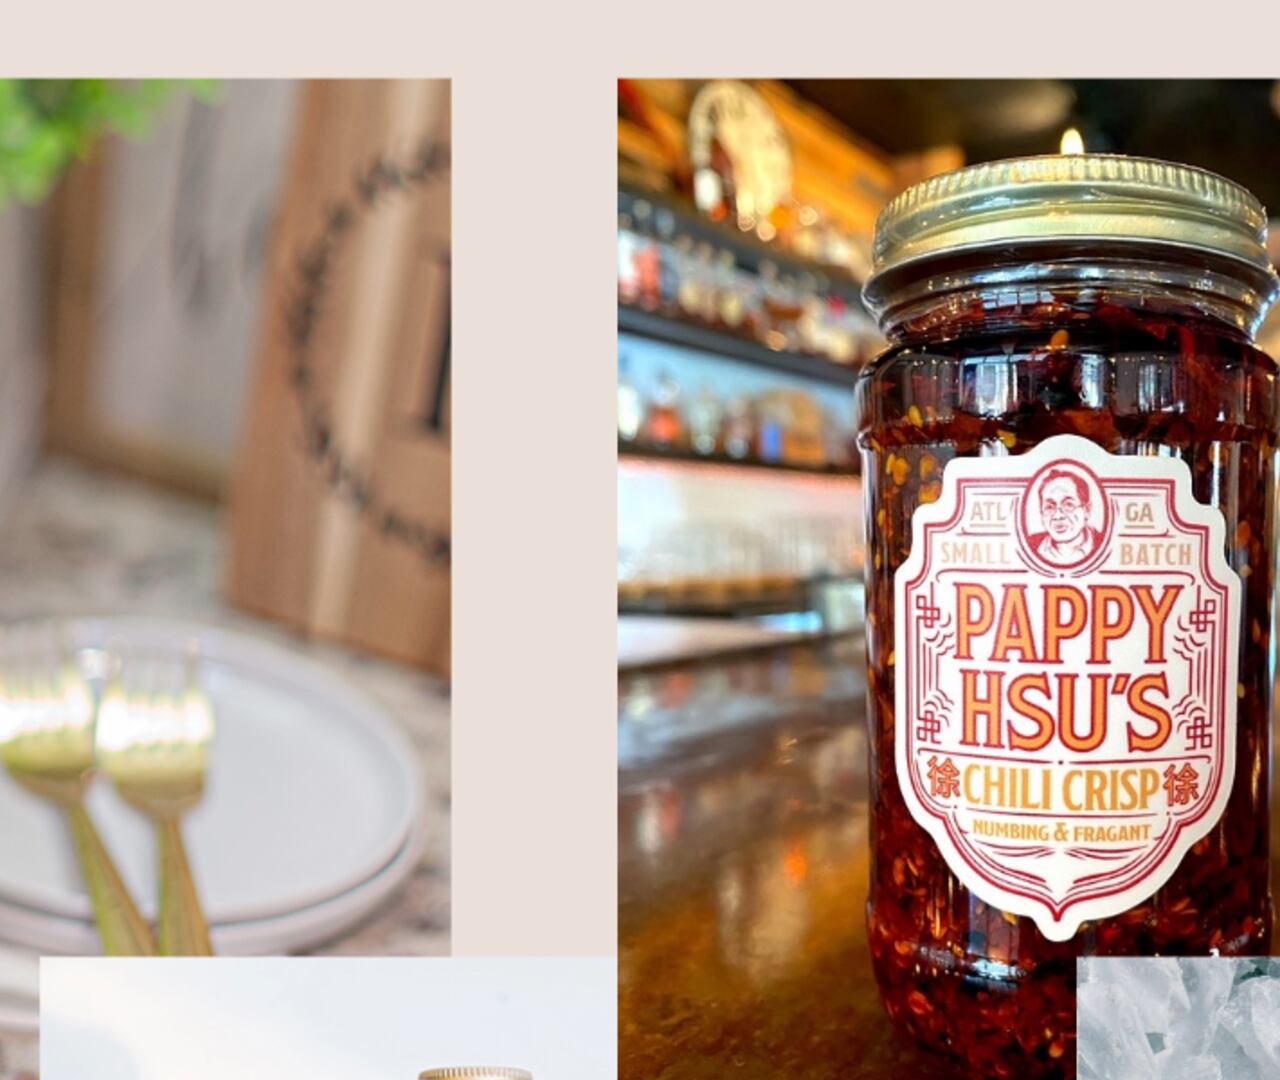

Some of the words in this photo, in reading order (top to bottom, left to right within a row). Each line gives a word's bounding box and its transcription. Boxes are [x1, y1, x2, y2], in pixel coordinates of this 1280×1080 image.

[970, 501, 1006, 522] ATL
[1126, 501, 1153, 522] GA
[942, 543, 1011, 564] SMALL
[1121, 544, 1191, 565] BATCH
[953, 582, 1185, 664] PAPPY
[960, 669, 1173, 753] HSU'S
[963, 766, 1050, 810] CHILI
[1062, 768, 1160, 811] CRISP
[973, 820, 1049, 840] NUMBING
[1053, 821, 1068, 841] &
[1073, 823, 1151, 841] FRAGANT
